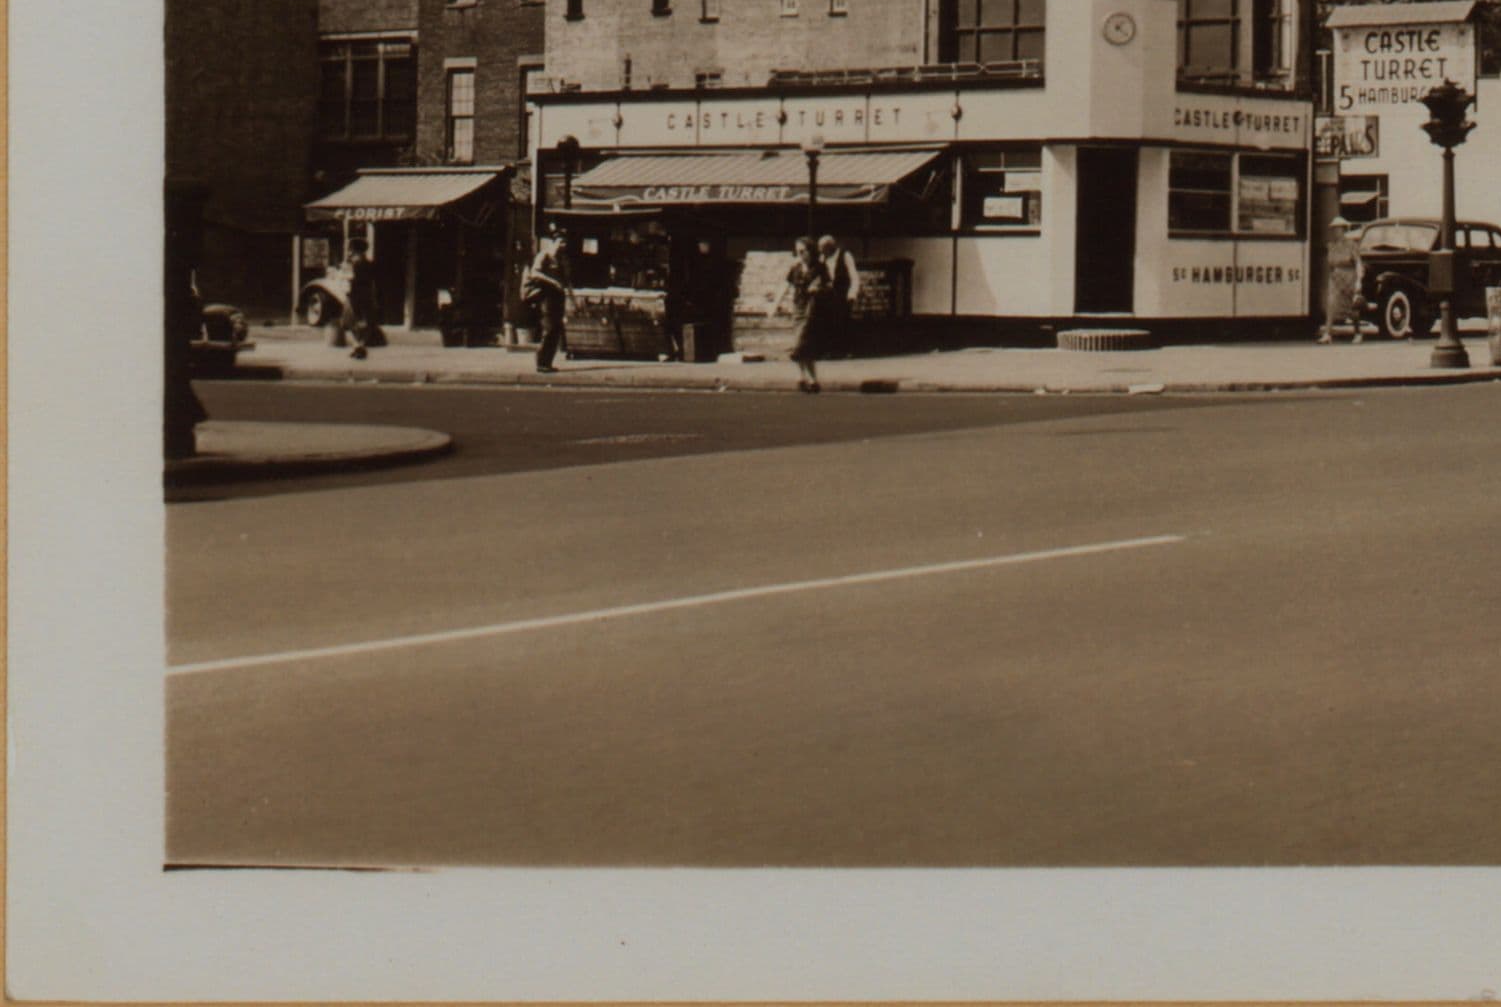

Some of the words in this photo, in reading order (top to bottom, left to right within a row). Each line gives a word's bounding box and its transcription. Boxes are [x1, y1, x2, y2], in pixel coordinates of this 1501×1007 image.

[1364, 29, 1441, 54] CASTLE
[1360, 57, 1447, 81] TURRET
[1339, 84, 1354, 110] 5
[667, 111, 765, 130] CASTLE
[799, 108, 901, 126] TURRET
[1174, 107, 1230, 129] CASTLE
[1246, 113, 1299, 133] TURRET
[644, 186, 713, 201] CASTLE
[719, 186, 790, 200] TURRET
[333, 207, 405, 220] FLORIST
[1192, 266, 1282, 284] HAMBURGER
